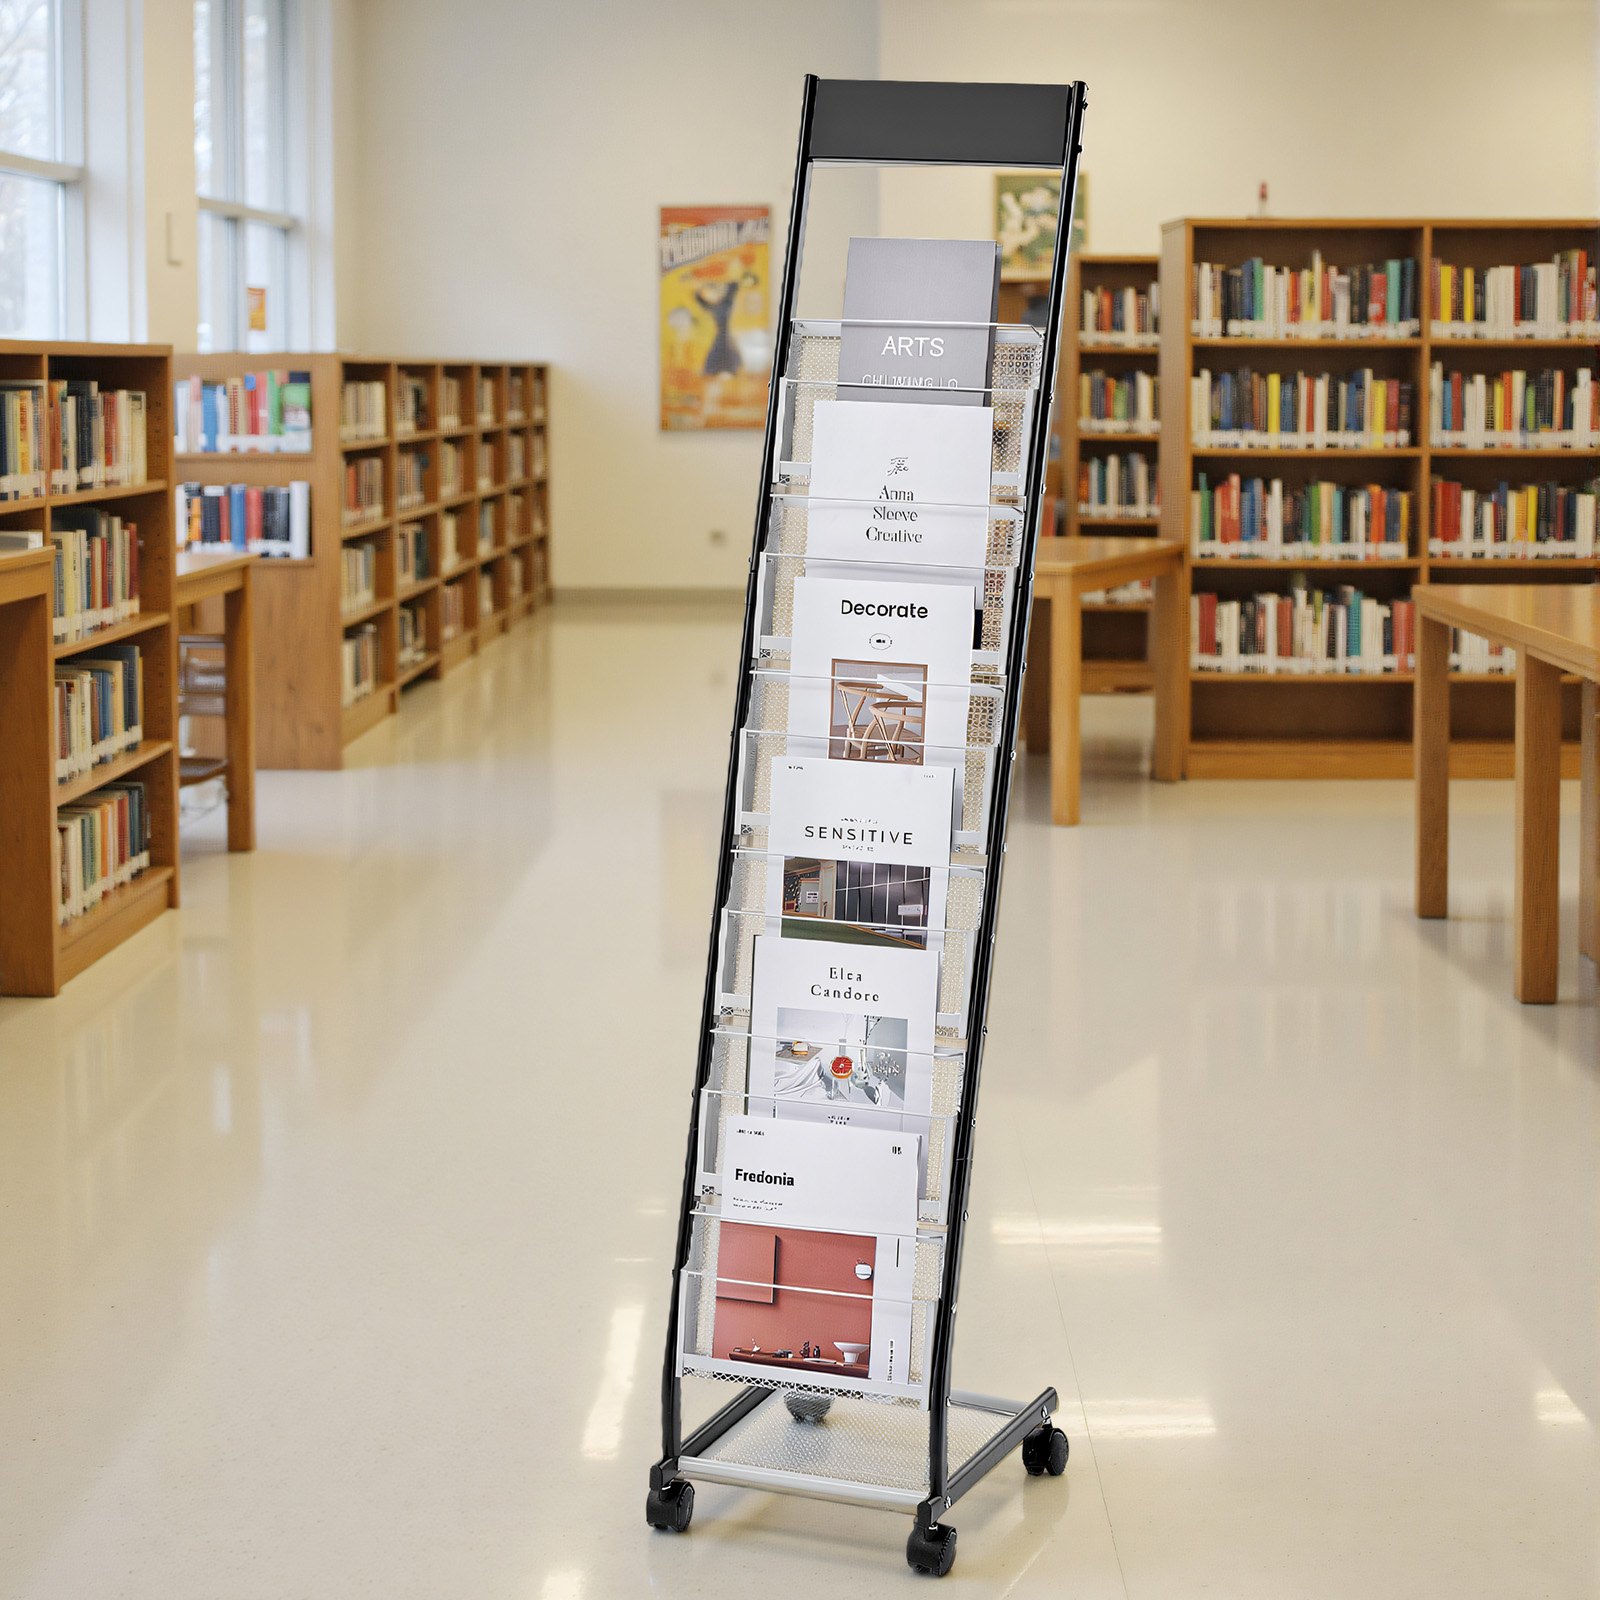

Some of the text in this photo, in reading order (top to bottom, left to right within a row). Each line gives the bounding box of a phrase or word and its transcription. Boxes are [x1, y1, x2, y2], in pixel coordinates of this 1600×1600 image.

[881, 335, 945, 357] ARTS
[878, 485, 914, 501] Anna
[873, 505, 919, 522] Sleeve
[865, 526, 923, 544] Creative
[841, 599, 928, 619] Decorate
[804, 825, 914, 845] SENSITIVE
[735, 1168, 795, 1187] Fredonia
